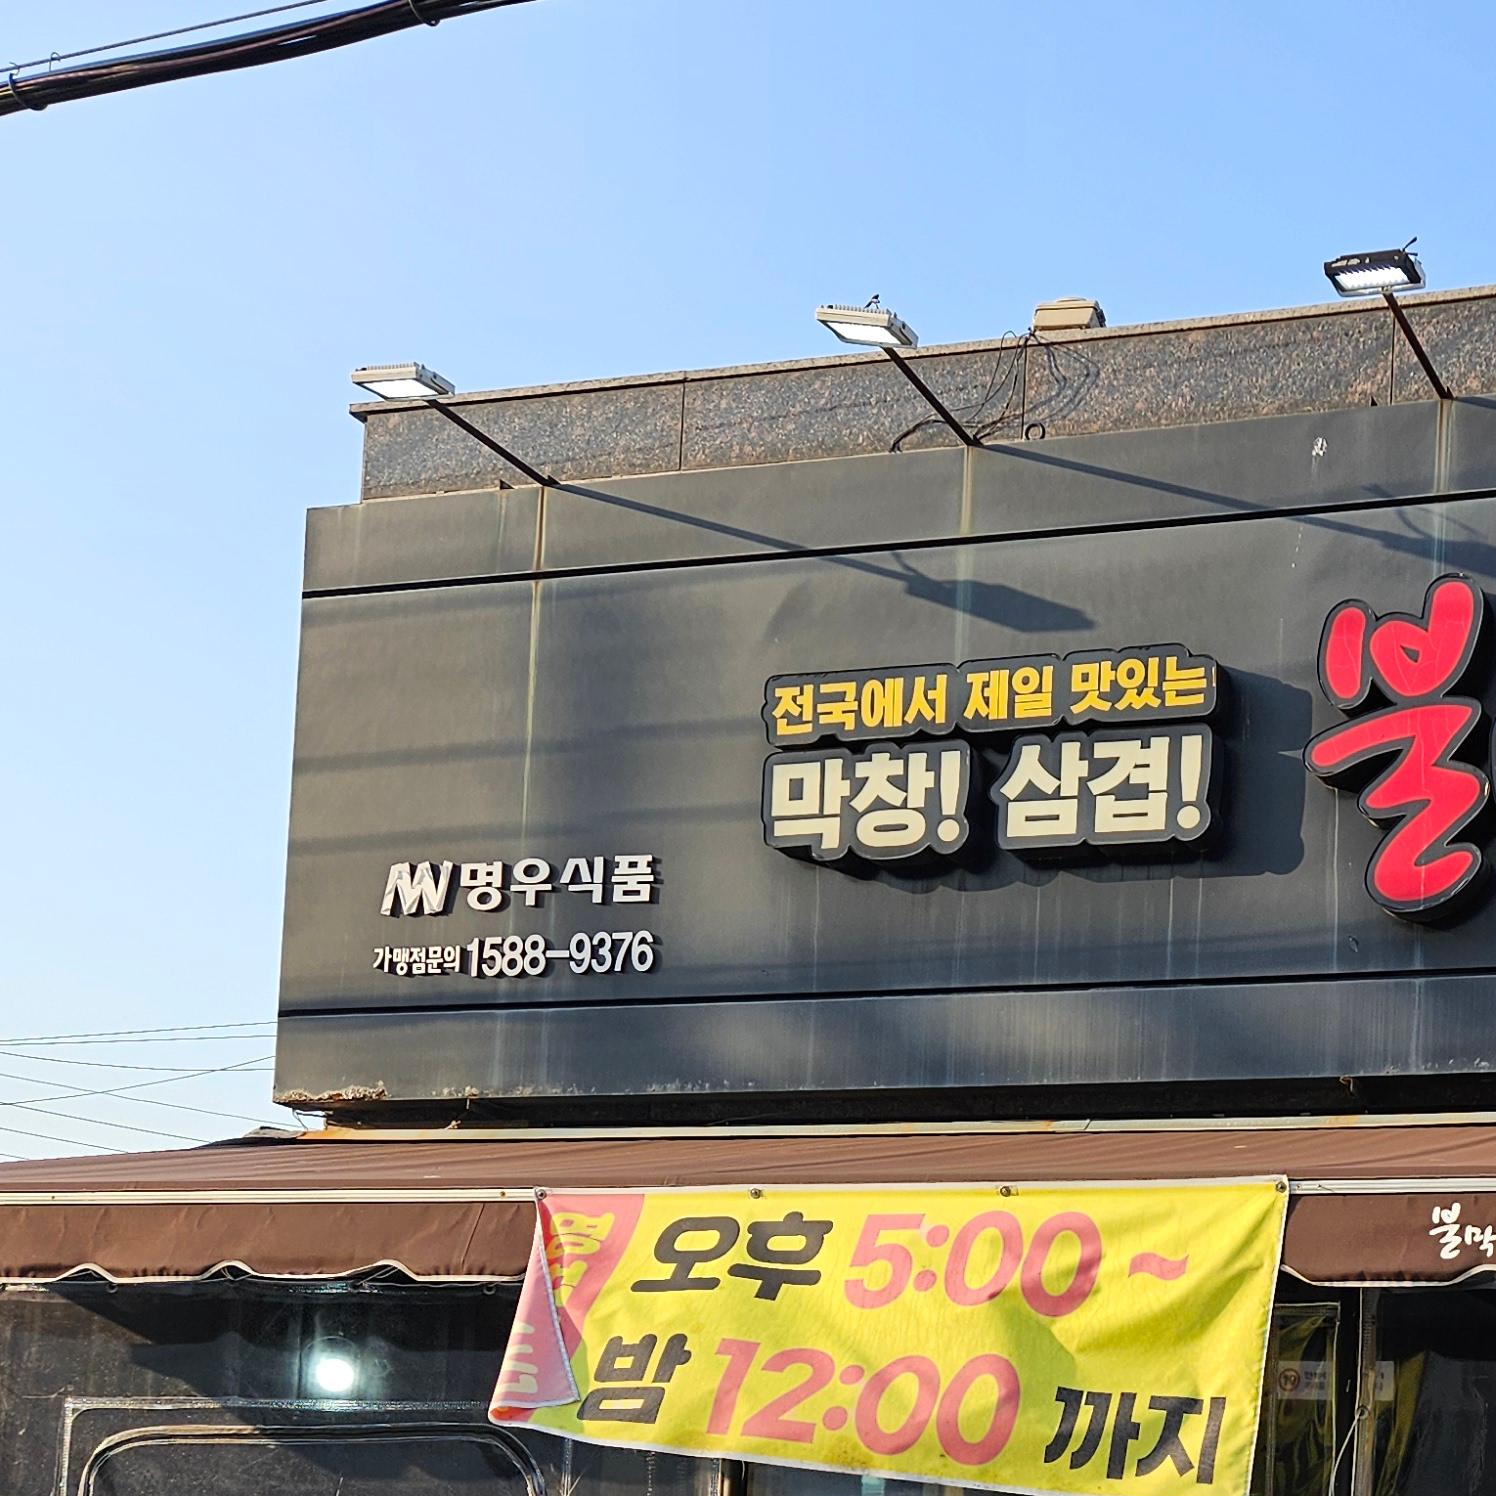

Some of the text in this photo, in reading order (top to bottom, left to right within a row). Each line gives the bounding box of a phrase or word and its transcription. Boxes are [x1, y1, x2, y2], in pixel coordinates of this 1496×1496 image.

[772, 655, 1212, 735] 전국에서 제일 맛있는
[770, 734, 1203, 849] 막창! 삼겹!
[460, 854, 655, 912] 명우식품
[372, 930, 654, 977] 가맹점문의 1588-9376
[630, 1211, 832, 1301] 오후
[844, 1211, 1102, 1317] 5:00
[576, 1332, 692, 1425] 밤
[703, 1336, 1020, 1467] 12:00
[1042, 1386, 1228, 1486] 까지
